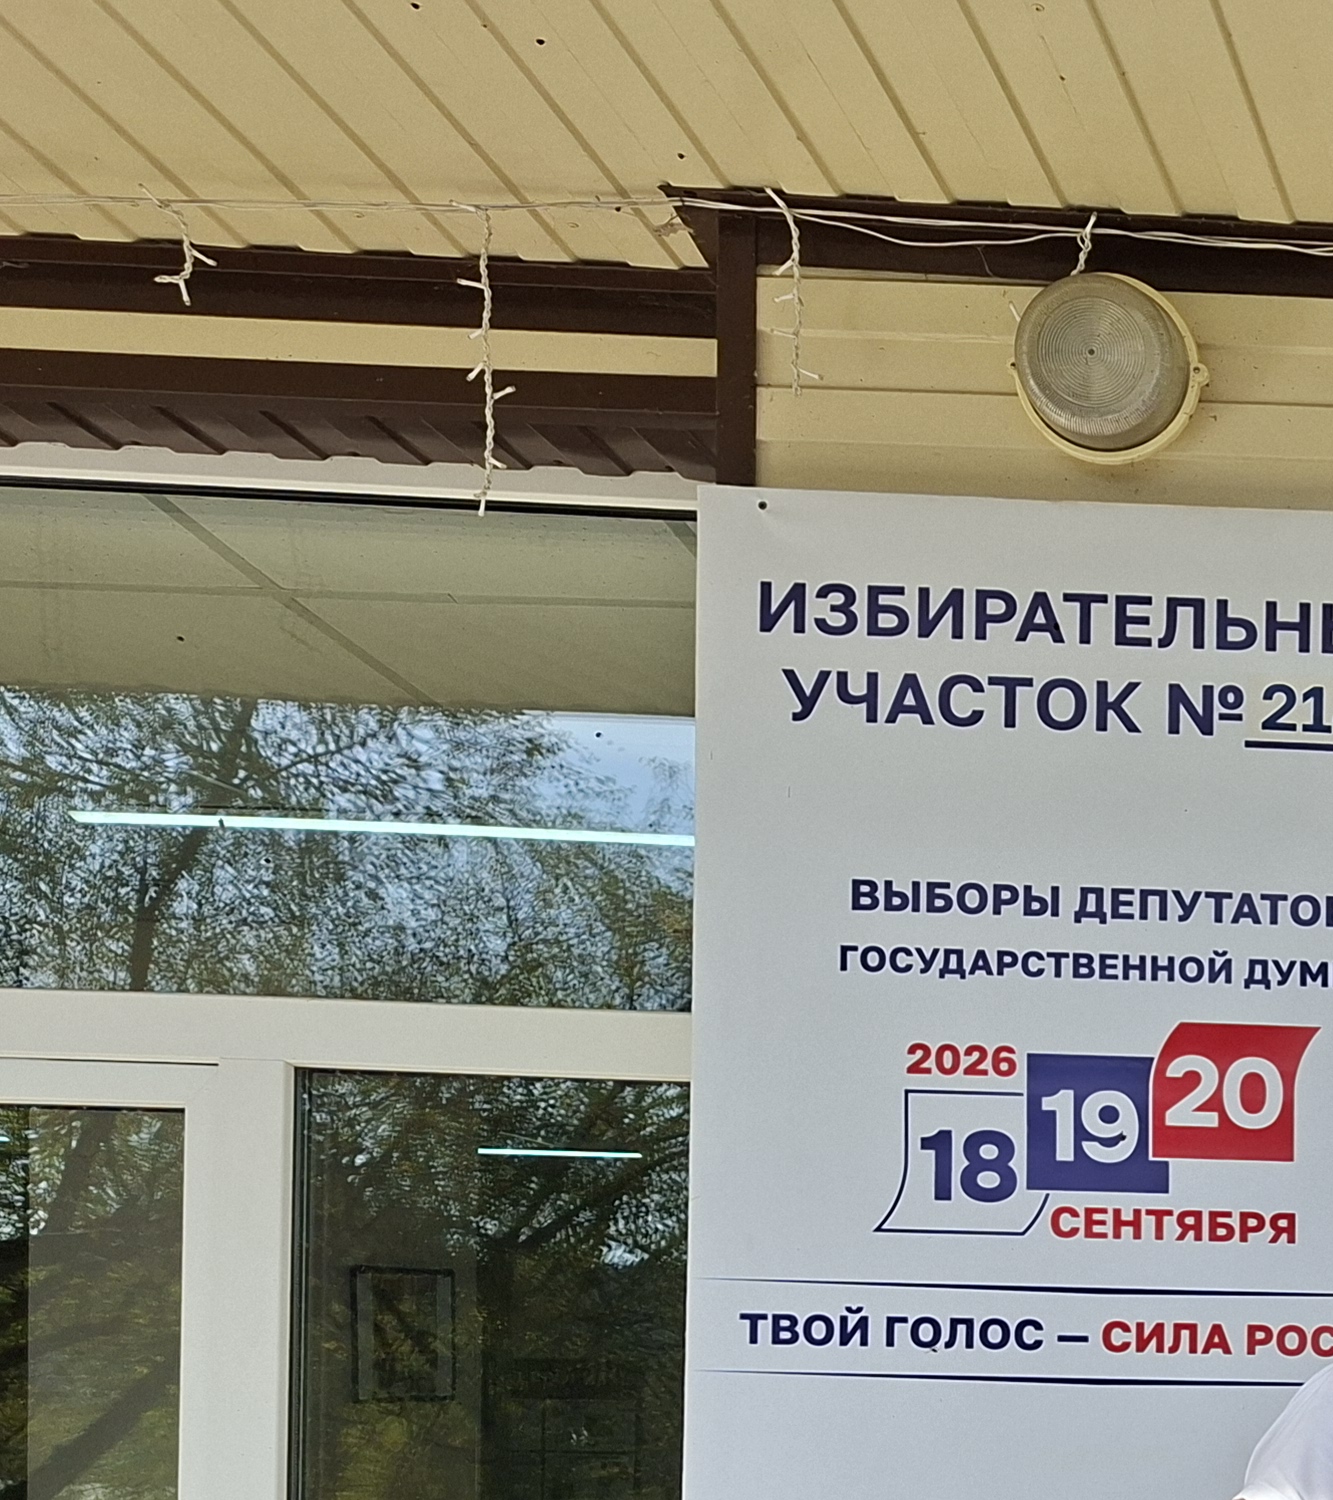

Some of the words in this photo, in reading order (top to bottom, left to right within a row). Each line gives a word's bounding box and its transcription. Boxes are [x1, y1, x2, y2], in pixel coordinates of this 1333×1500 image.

[782, 669, 1141, 733] УЧАСТОК
[1168, 684, 1243, 736] №
[852, 879, 1059, 917] ВЫБОРЫ
[840, 945, 1232, 984] ГОСУДАРСТВЕННОЙ
[907, 1043, 1016, 1077] 2026
[921, 1130, 1017, 1202] 18
[1042, 1090, 1139, 1163] 19
[1165, 1055, 1283, 1129] 20
[1051, 1207, 1295, 1244] СЕНТЯБРЯ
[740, 1307, 868, 1346] ТВОЙ
[886, 1317, 1043, 1350] ГОЛОС
[1103, 1321, 1231, 1354] СИЛА
